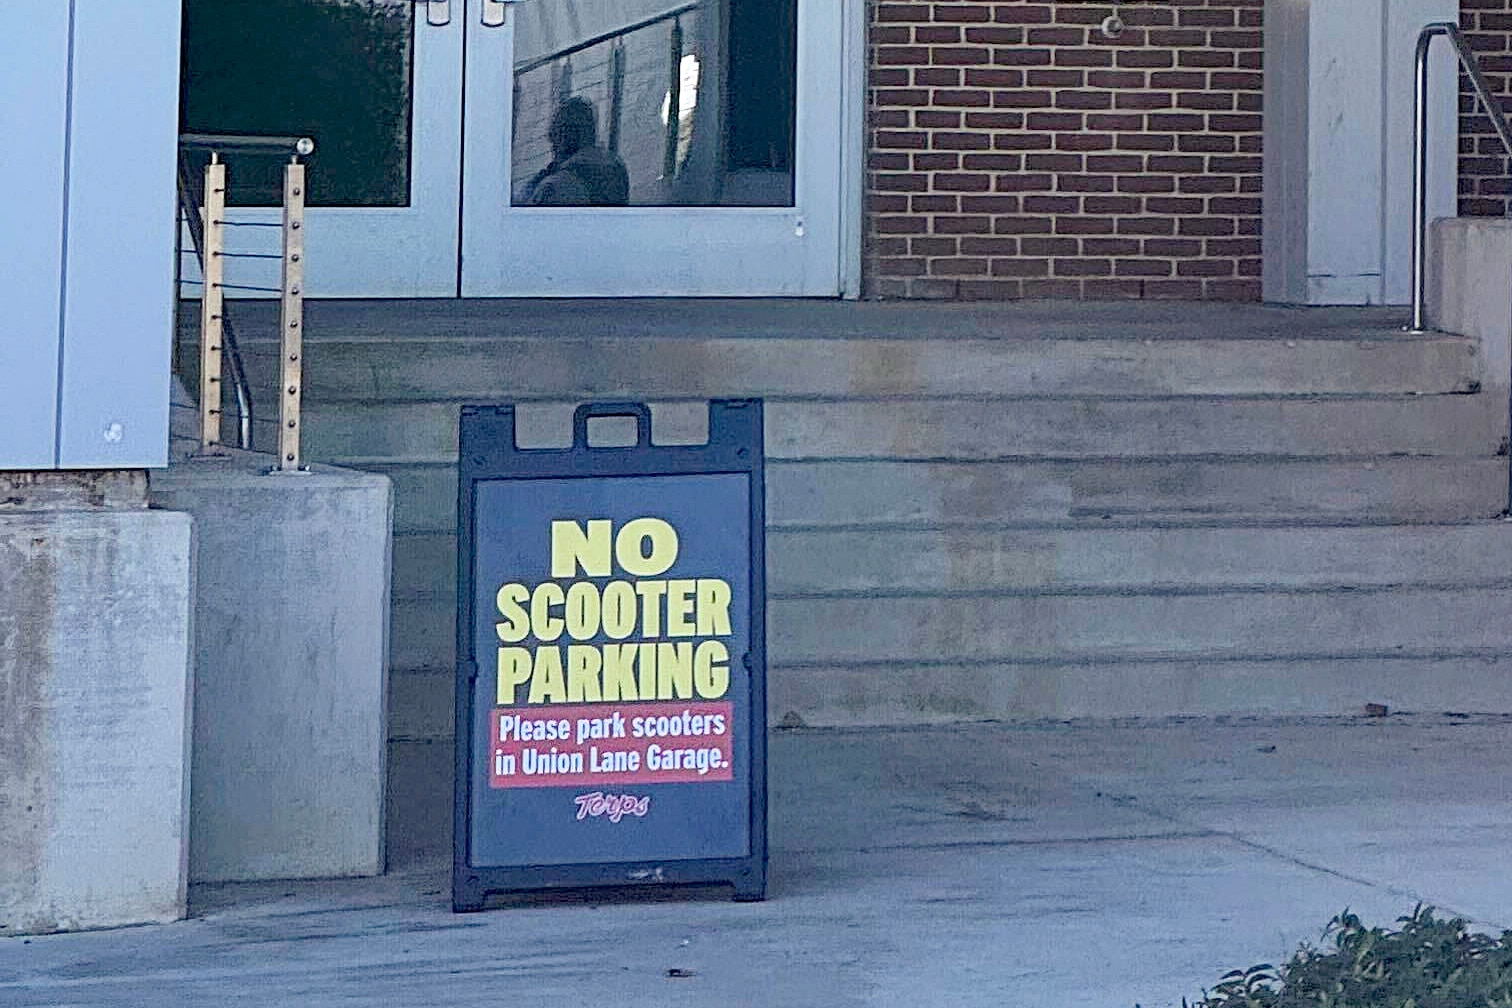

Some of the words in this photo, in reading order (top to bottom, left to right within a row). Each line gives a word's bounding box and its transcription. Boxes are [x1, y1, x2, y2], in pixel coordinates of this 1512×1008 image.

[551, 517, 679, 578] NO
[495, 578, 733, 642] SCOOTER
[496, 640, 730, 705] PARKING
[500, 714, 571, 742] Please
[576, 711, 626, 745] park
[632, 710, 726, 738] scooters
[495, 748, 516, 775] in
[522, 746, 584, 775] Union
[590, 746, 640, 773] Lane
[646, 744, 729, 775] Garage.
[574, 792, 650, 823] Terps
